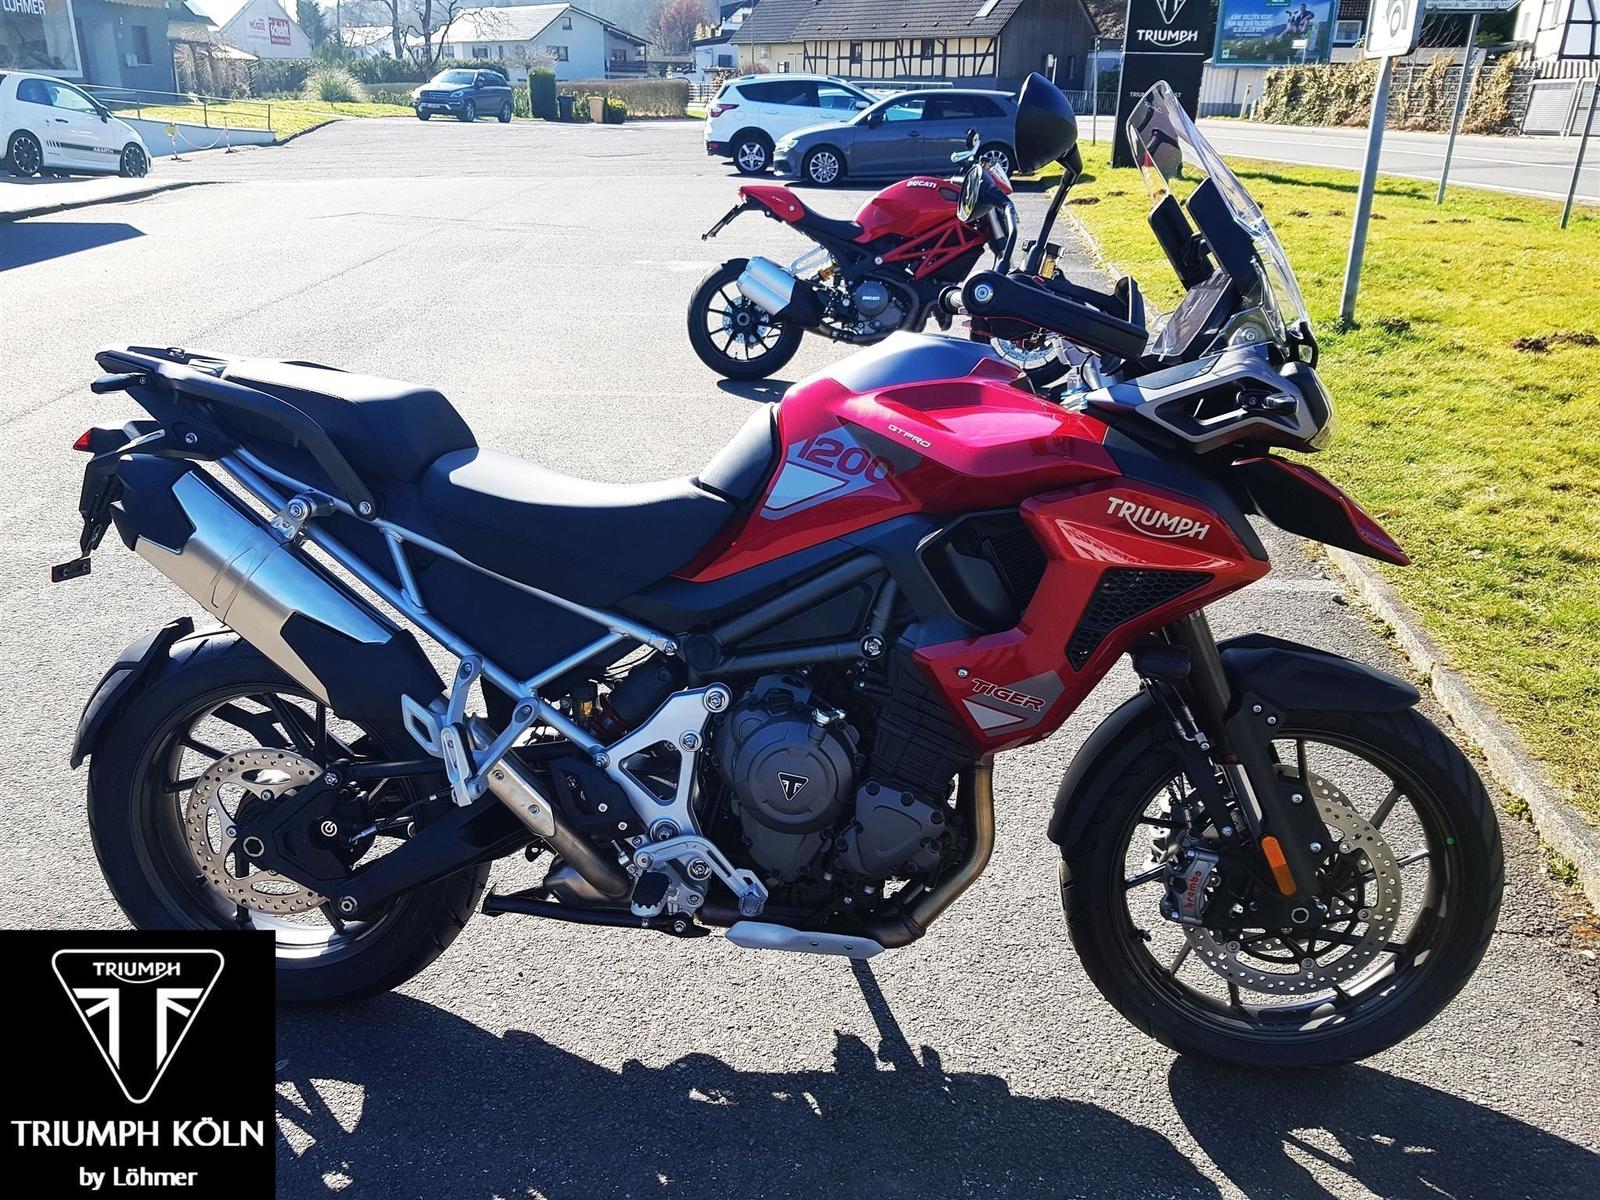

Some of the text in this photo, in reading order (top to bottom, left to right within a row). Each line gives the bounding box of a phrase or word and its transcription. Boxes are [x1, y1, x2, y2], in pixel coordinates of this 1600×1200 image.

[1136, 29, 1198, 47] TRIUMPH
[906, 180, 937, 189] DUCATI
[797, 436, 895, 481] 1200
[1106, 496, 1210, 541] TRIUMPH
[971, 677, 1046, 713] TIGER
[1184, 870, 1202, 910] brembo
